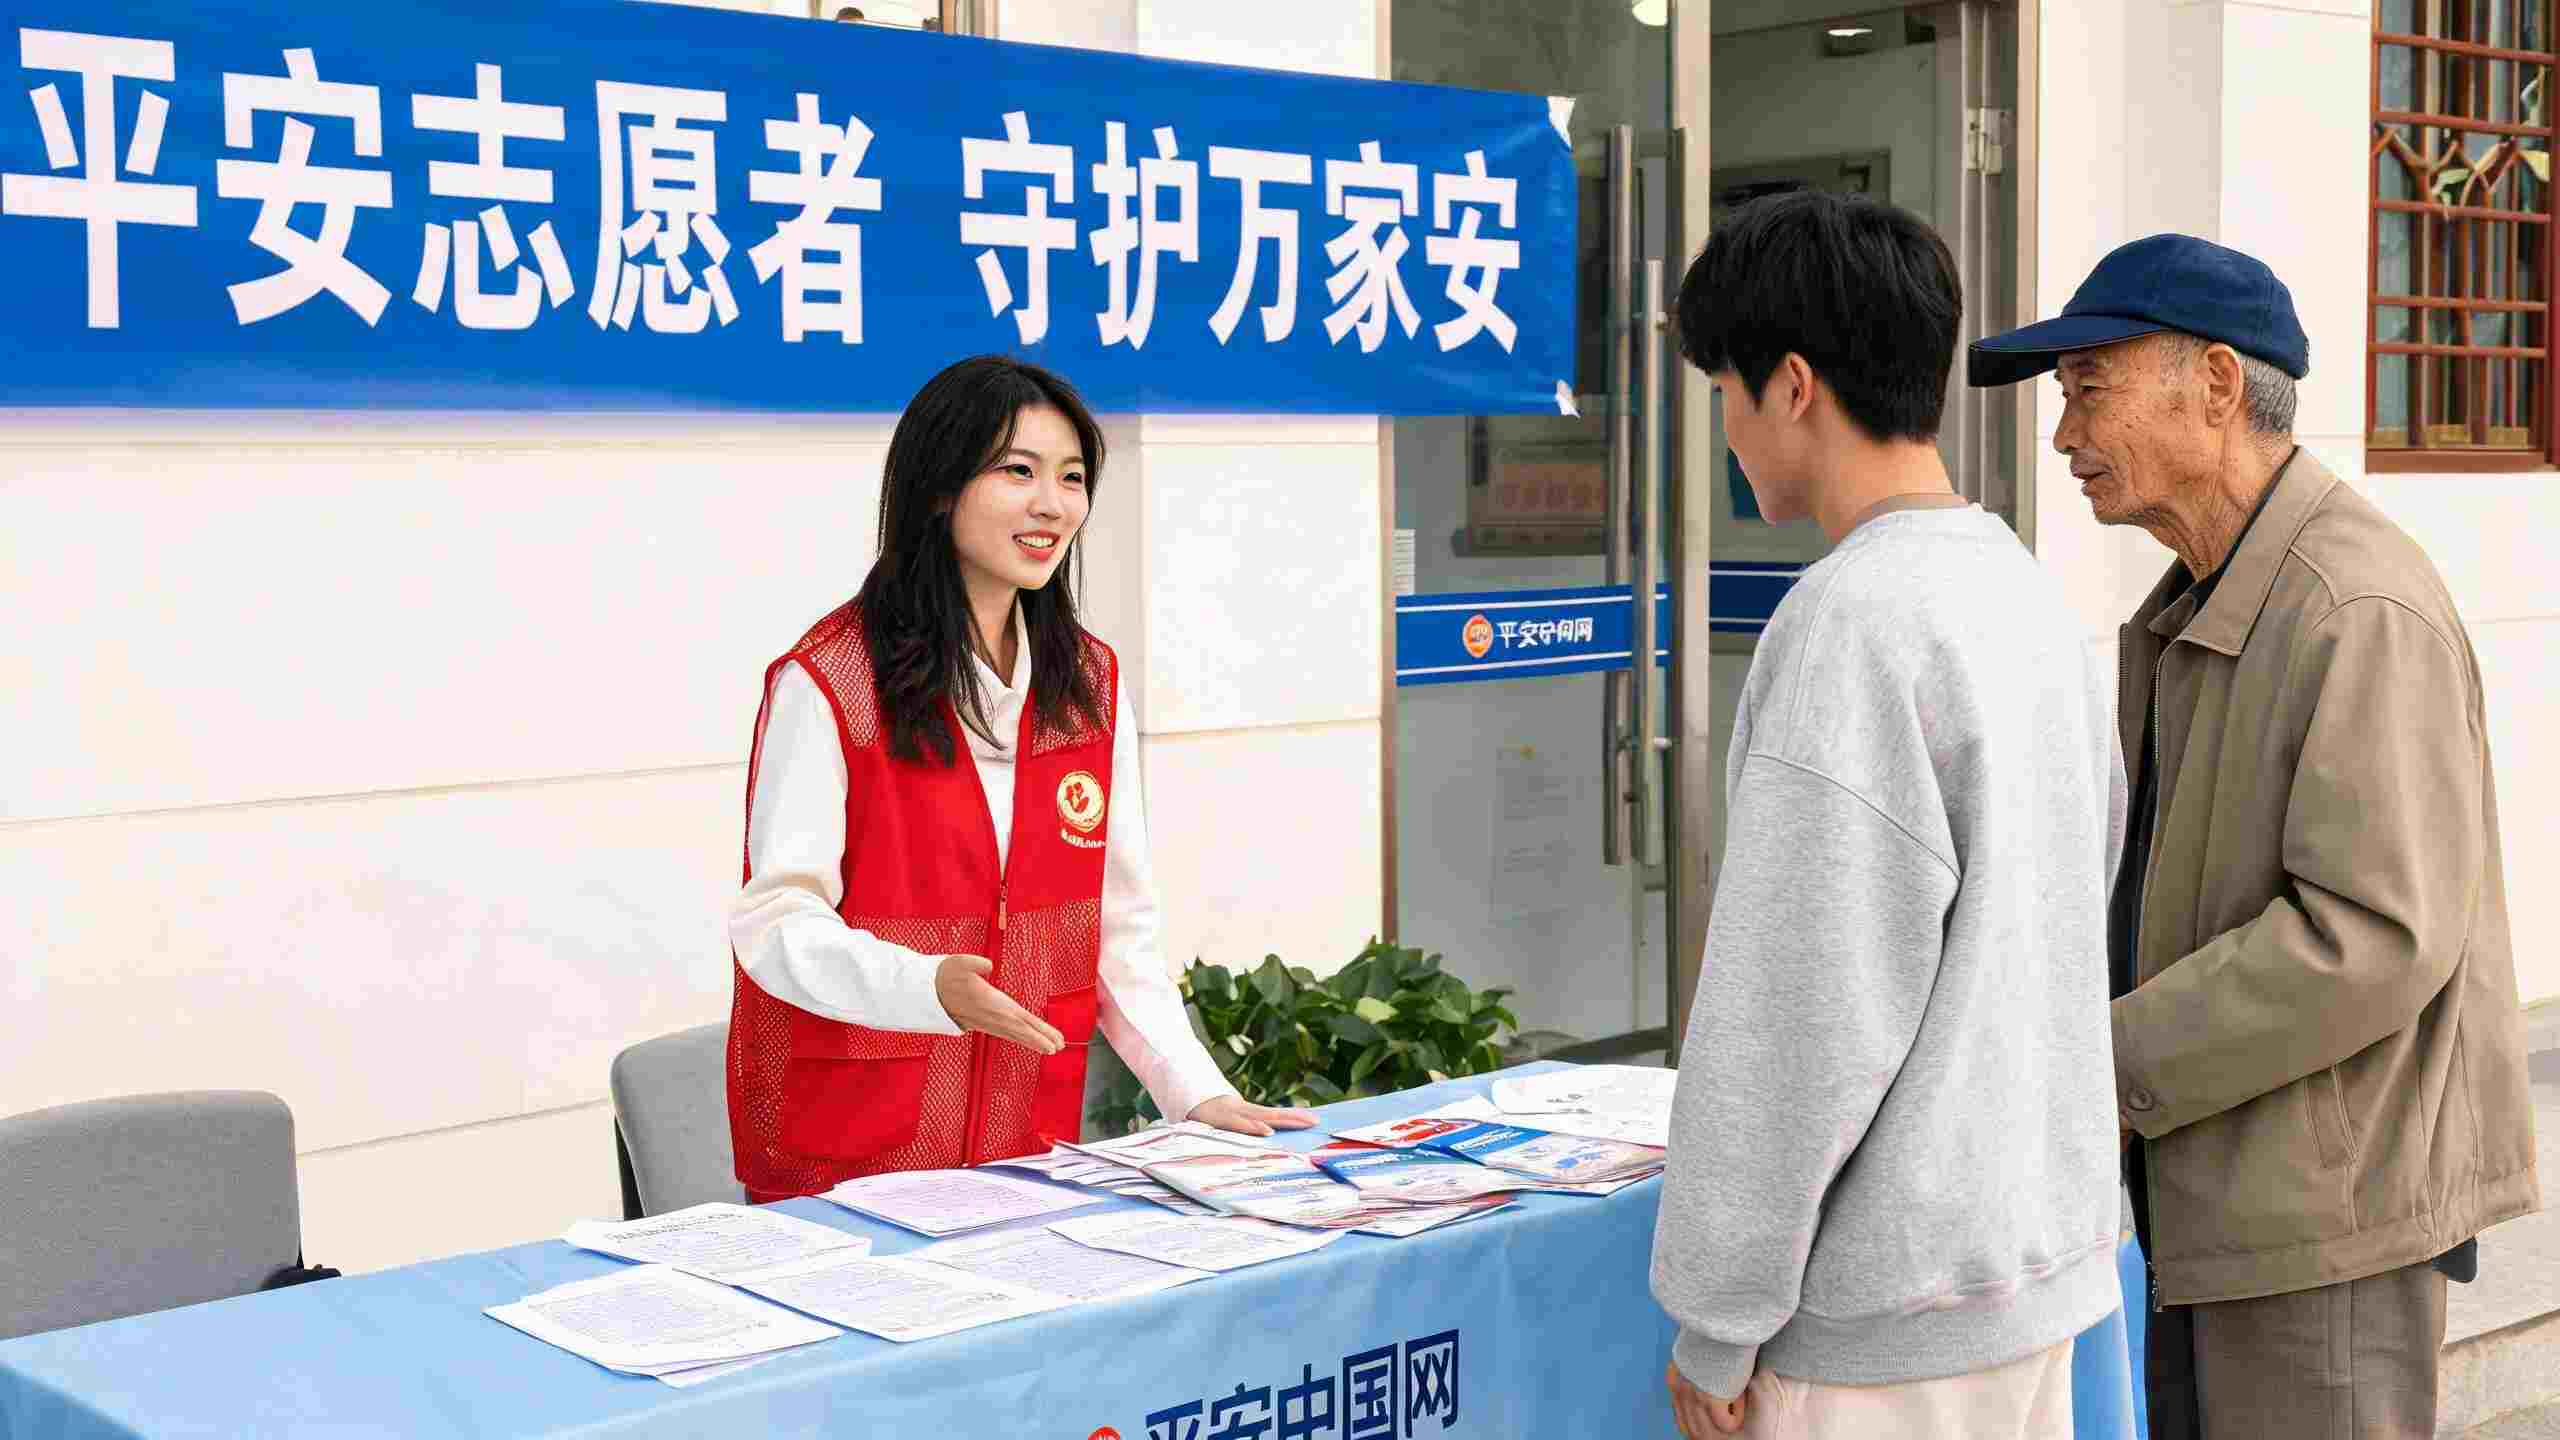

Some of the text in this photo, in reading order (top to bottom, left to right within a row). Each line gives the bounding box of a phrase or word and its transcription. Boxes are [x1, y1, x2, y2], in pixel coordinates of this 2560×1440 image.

[1, 27, 1521, 355] 平安志愿者 守护万家安
